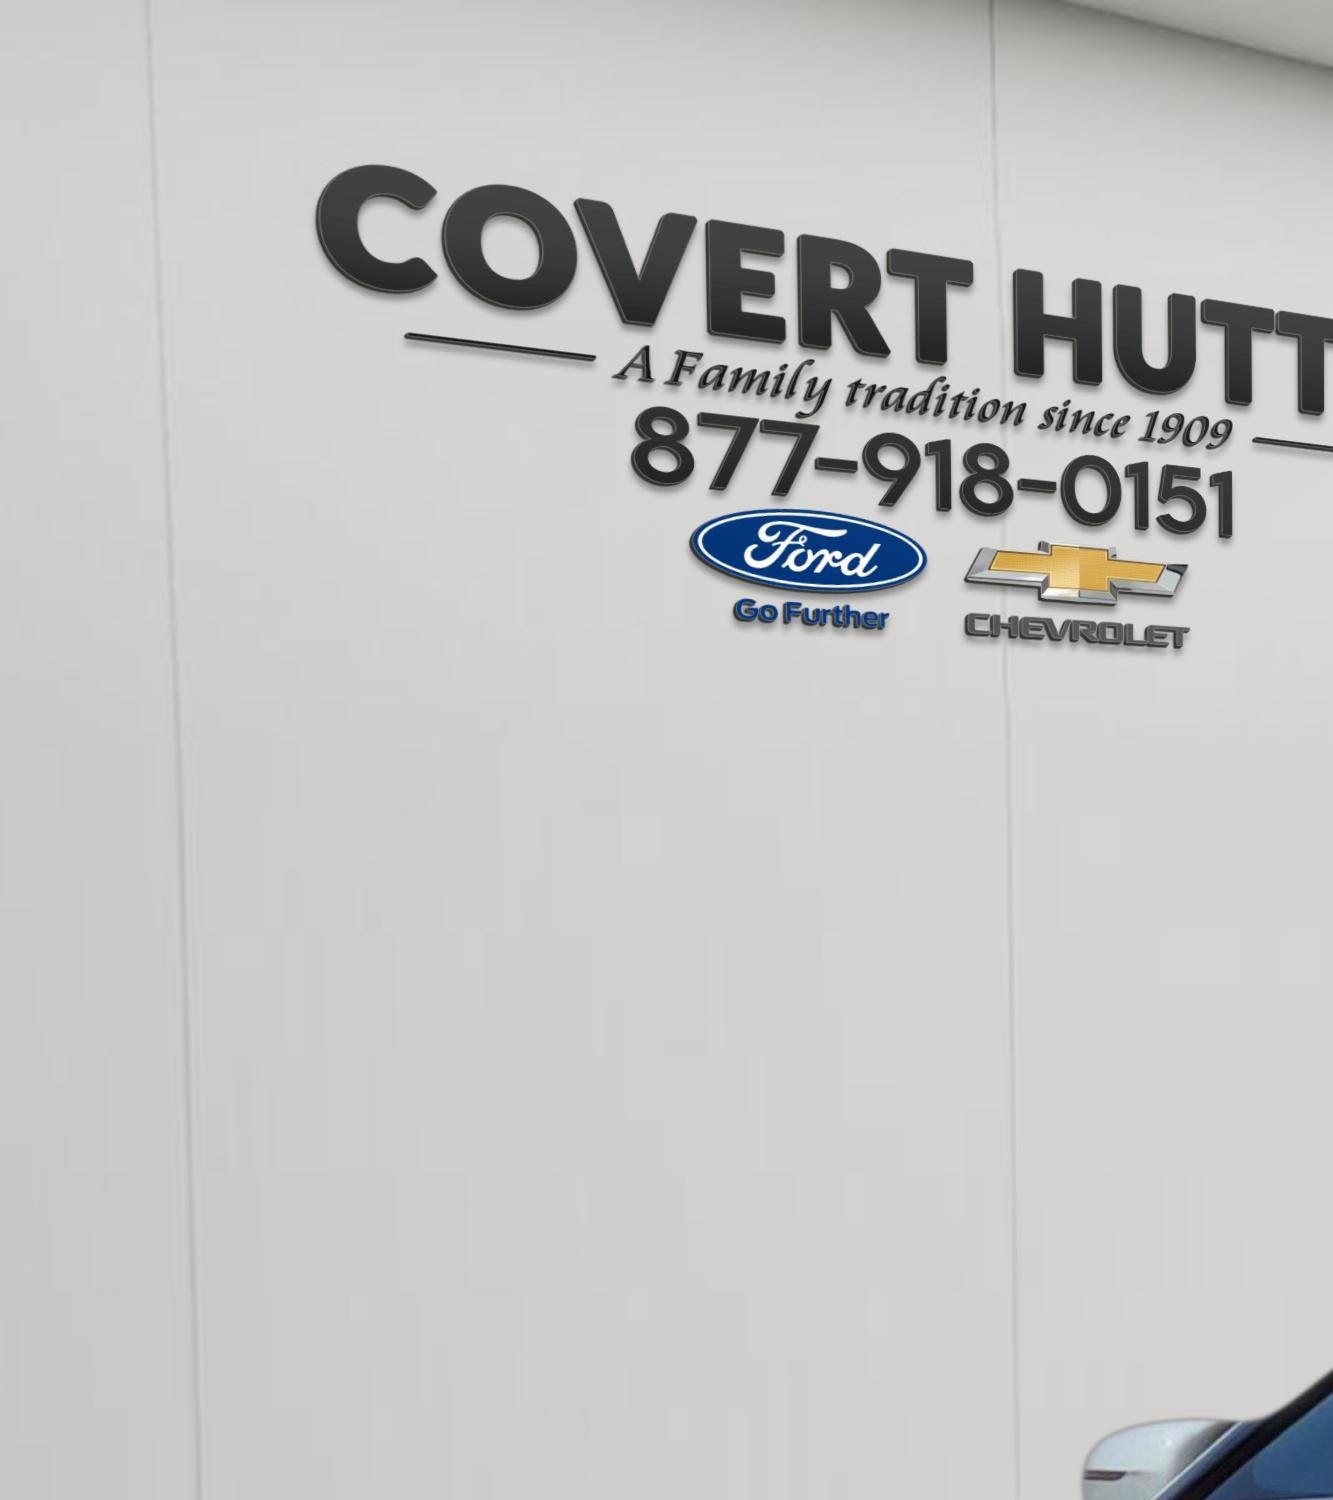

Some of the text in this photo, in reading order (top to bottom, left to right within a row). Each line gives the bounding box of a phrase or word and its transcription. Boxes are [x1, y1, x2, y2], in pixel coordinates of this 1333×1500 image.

[315, 164, 975, 368] COVERT
[611, 344, 1234, 451] A Family tradition since 1909
[630, 406, 1234, 540] 877-918-0151
[744, 520, 881, 580] Ford
[733, 598, 890, 631] Go Further
[964, 612, 1191, 650] CHEVROLET
